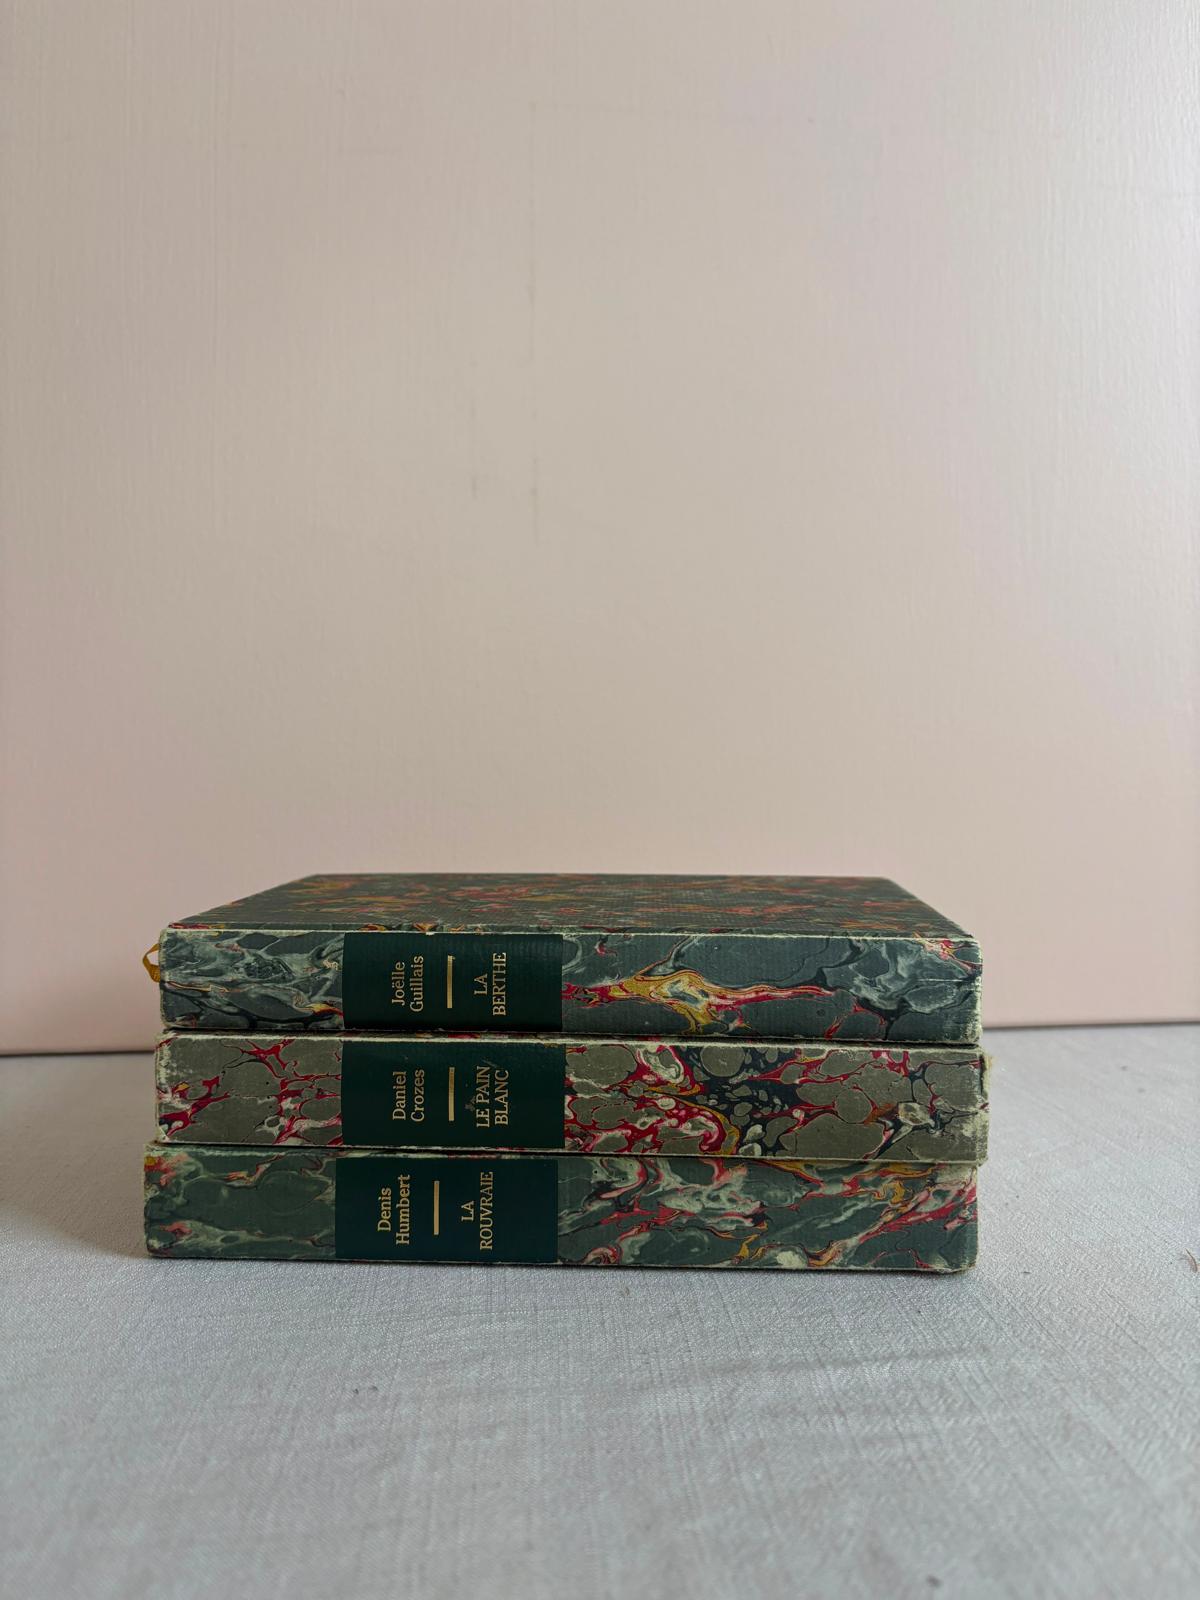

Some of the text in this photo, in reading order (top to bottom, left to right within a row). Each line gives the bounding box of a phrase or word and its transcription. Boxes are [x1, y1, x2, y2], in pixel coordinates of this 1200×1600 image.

[391, 961, 405, 1006] Joëlle
[409, 955, 424, 1012] Guillais
[474, 973, 488, 996] LA
[492, 952, 507, 1016] BERTHE
[392, 1071, 407, 1120] Daniel
[411, 1069, 425, 1122] Crozes
[475, 1065, 491, 1128] LE PAIN
[494, 1069, 509, 1125] BLANC
[377, 1187, 392, 1232] Denis
[395, 1174, 411, 1245] Humbert
[461, 1200, 475, 1222] LA
[479, 1171, 494, 1250] ROUVRAIE
